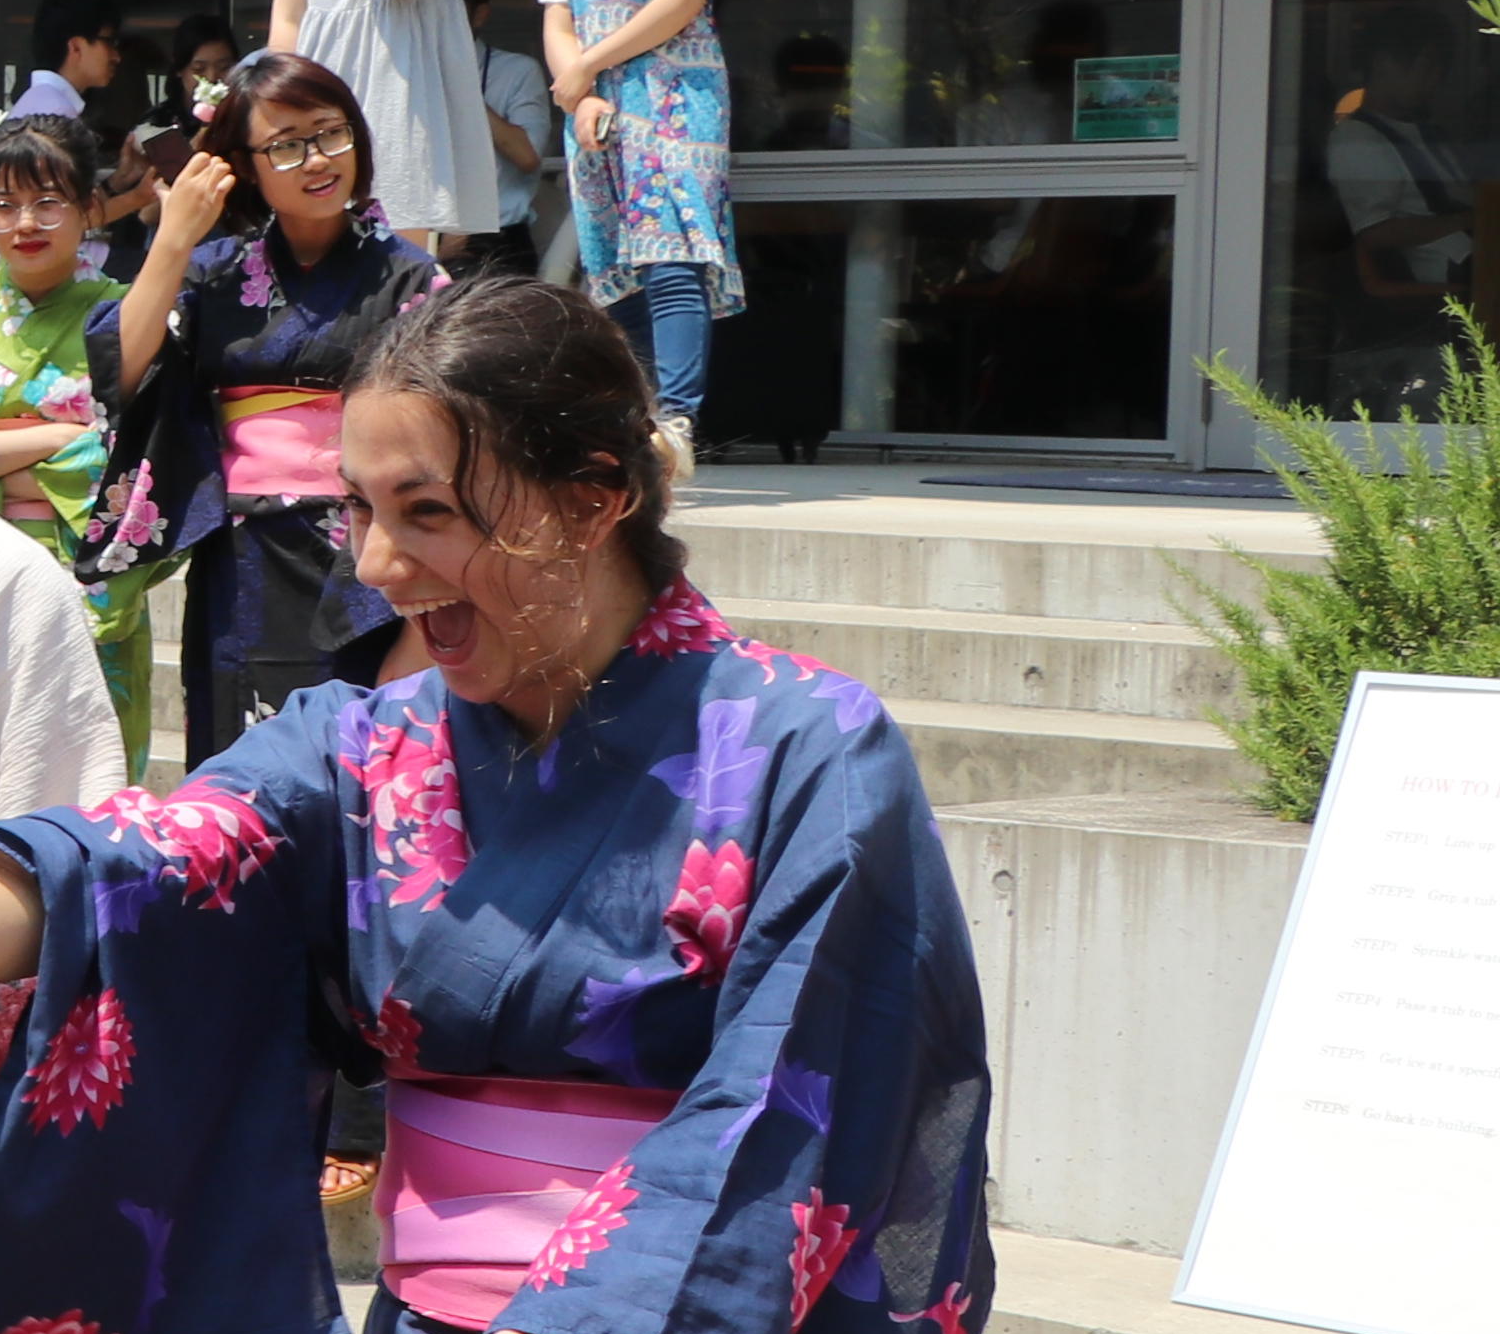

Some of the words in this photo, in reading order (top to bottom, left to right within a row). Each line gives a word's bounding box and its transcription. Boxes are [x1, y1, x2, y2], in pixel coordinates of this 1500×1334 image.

[1401, 775, 1453, 793] HOW
[1461, 779, 1490, 796] TO
[1384, 830, 1429, 845] STEP1
[1444, 835, 1475, 849] Line
[1478, 841, 1496, 852] up
[1367, 883, 1415, 899] STEP2
[1460, 896, 1470, 904] a
[1474, 894, 1497, 906] tub
[1412, 945, 1471, 961] Sprinkle
[1335, 991, 1383, 1007] STEP4
[1395, 998, 1427, 1011] Pass
[1430, 1004, 1439, 1013] a
[1441, 1004, 1466, 1016] tub
[1469, 1008, 1483, 1018] to
[1379, 1052, 1403, 1066] Get
[1406, 1056, 1426, 1068] ice
[1428, 1061, 1443, 1072] at
[1446, 1064, 1455, 1073] a
[1302, 1099, 1349, 1115] STEP6
[1362, 1107, 1382, 1120] Go
[1384, 1110, 1415, 1125] back
[1420, 1116, 1435, 1127] to
